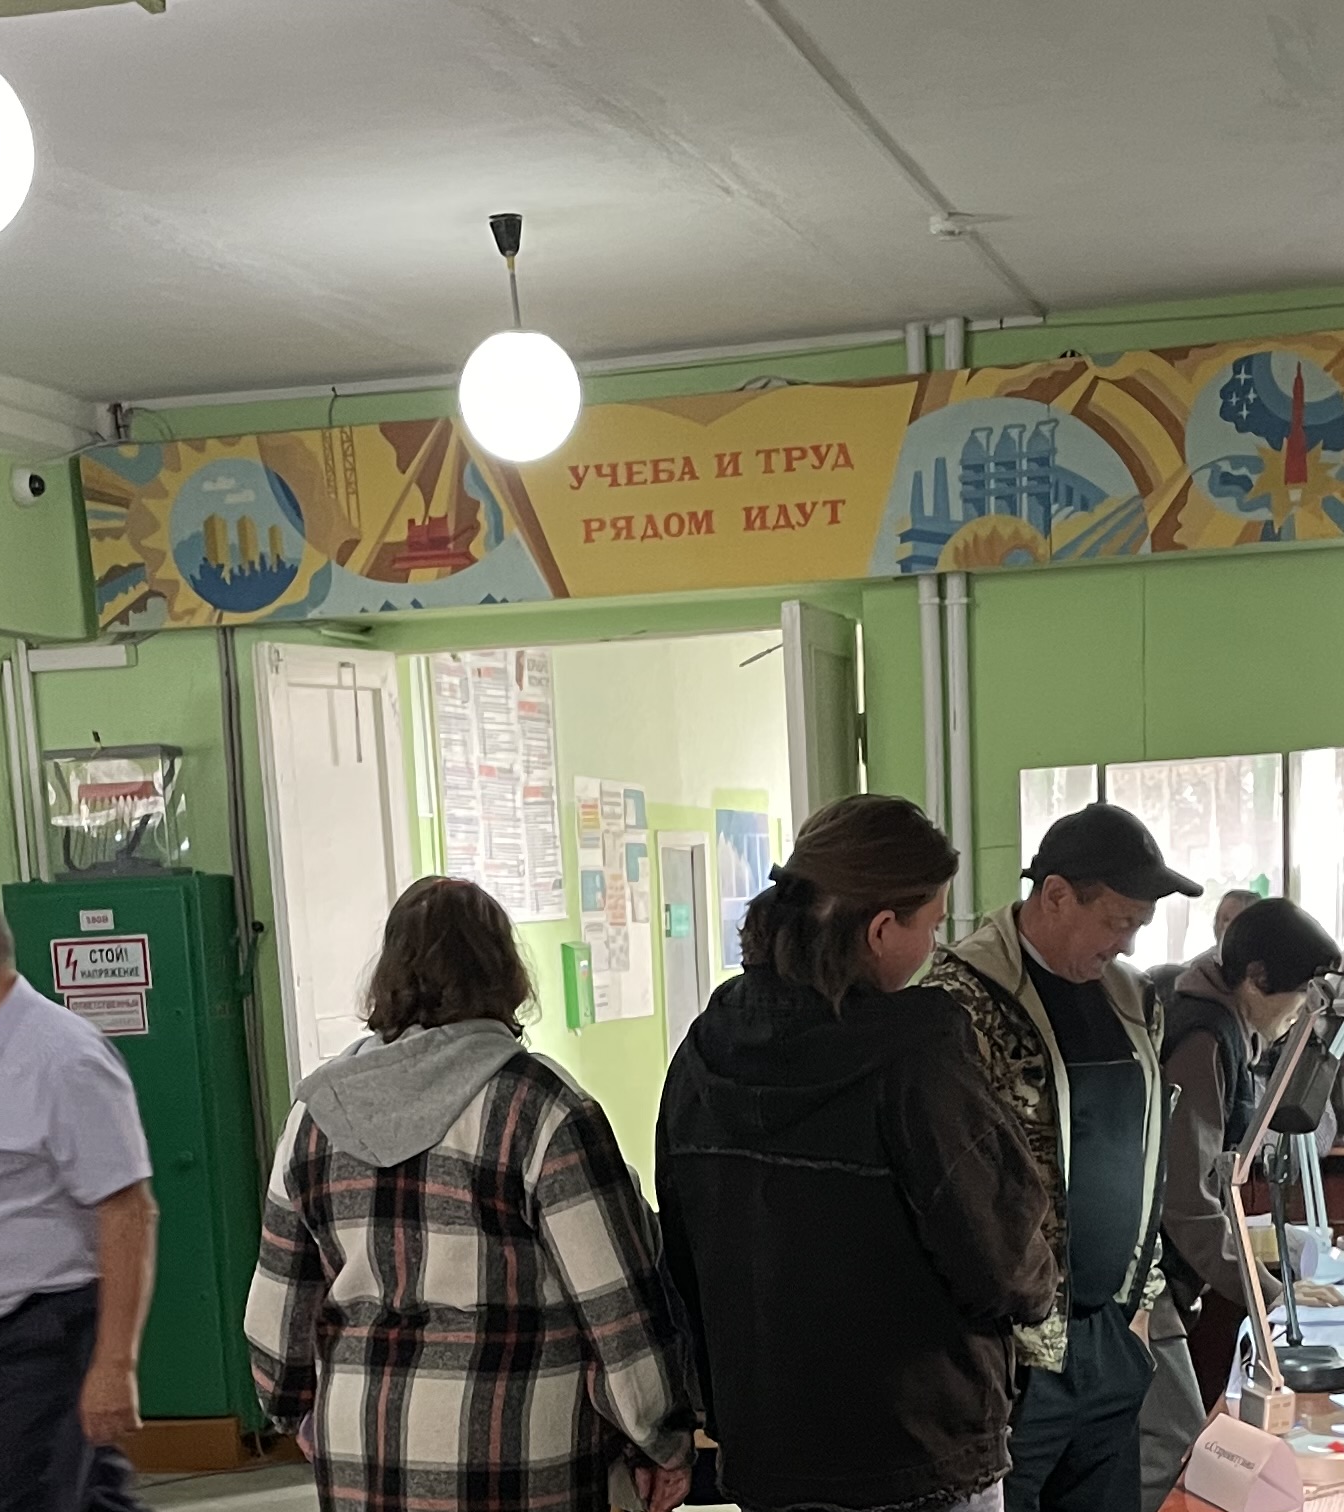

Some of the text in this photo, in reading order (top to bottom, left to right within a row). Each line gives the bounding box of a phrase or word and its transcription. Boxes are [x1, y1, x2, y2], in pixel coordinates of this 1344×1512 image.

[567, 442, 855, 490] УЧЕБА И ТРУД
[582, 499, 846, 544] РЯДОМ ИДУТ
[89, 944, 129, 964] СТОЙ!
[79, 966, 140, 979] НАПРЯЖЕНИЕ
